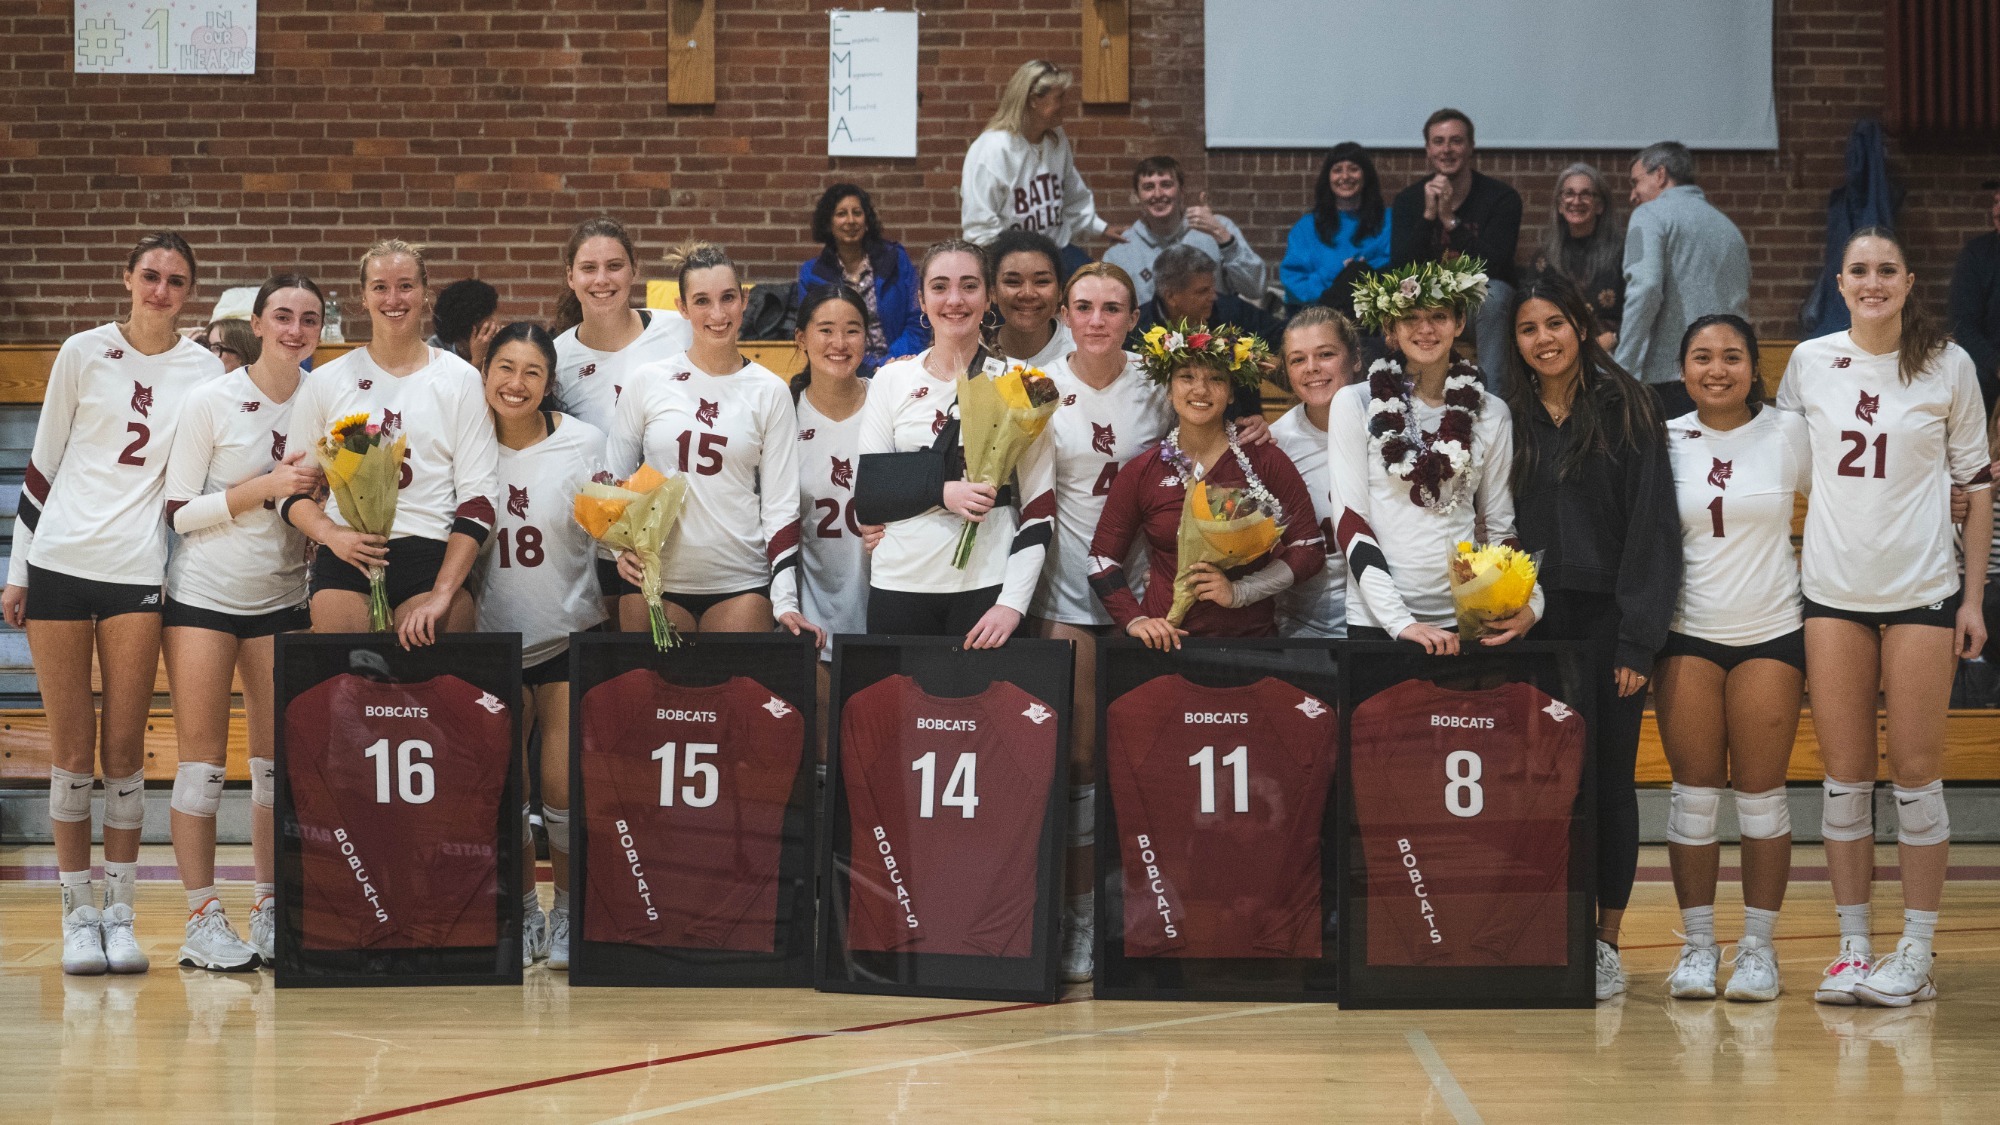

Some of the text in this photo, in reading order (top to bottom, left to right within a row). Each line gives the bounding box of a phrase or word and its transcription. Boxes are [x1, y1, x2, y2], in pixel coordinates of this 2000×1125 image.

[203, 31, 232, 45] OUR
[206, 11, 232, 29] IN
[180, 45, 255, 70] HEARTS
[1014, 173, 1065, 214] BATE
[1829, 357, 1851, 368] NB
[117, 421, 151, 466] 2
[676, 430, 728, 476] 15
[1838, 430, 1887, 479] 21
[1707, 496, 1725, 538] 1
[497, 525, 545, 569] 18
[365, 706, 429, 718] BOBCATS
[656, 708, 717, 723] BOBCATS
[916, 717, 977, 731] BOBCATS
[1184, 712, 1248, 724] BOBCATS
[1431, 714, 1495, 729] BOBCATS
[364, 738, 435, 804] 16
[651, 741, 719, 808] 15
[911, 751, 979, 818] 14
[1188, 745, 1249, 813] 11
[1444, 750, 1484, 818] 8
[333, 828, 389, 923] BOBCATS
[615, 819, 659, 921] BOBCATS
[873, 826, 919, 928] BOBCATS
[1137, 834, 1177, 939] BOBCATS
[1397, 838, 1442, 944] BOBCATS
